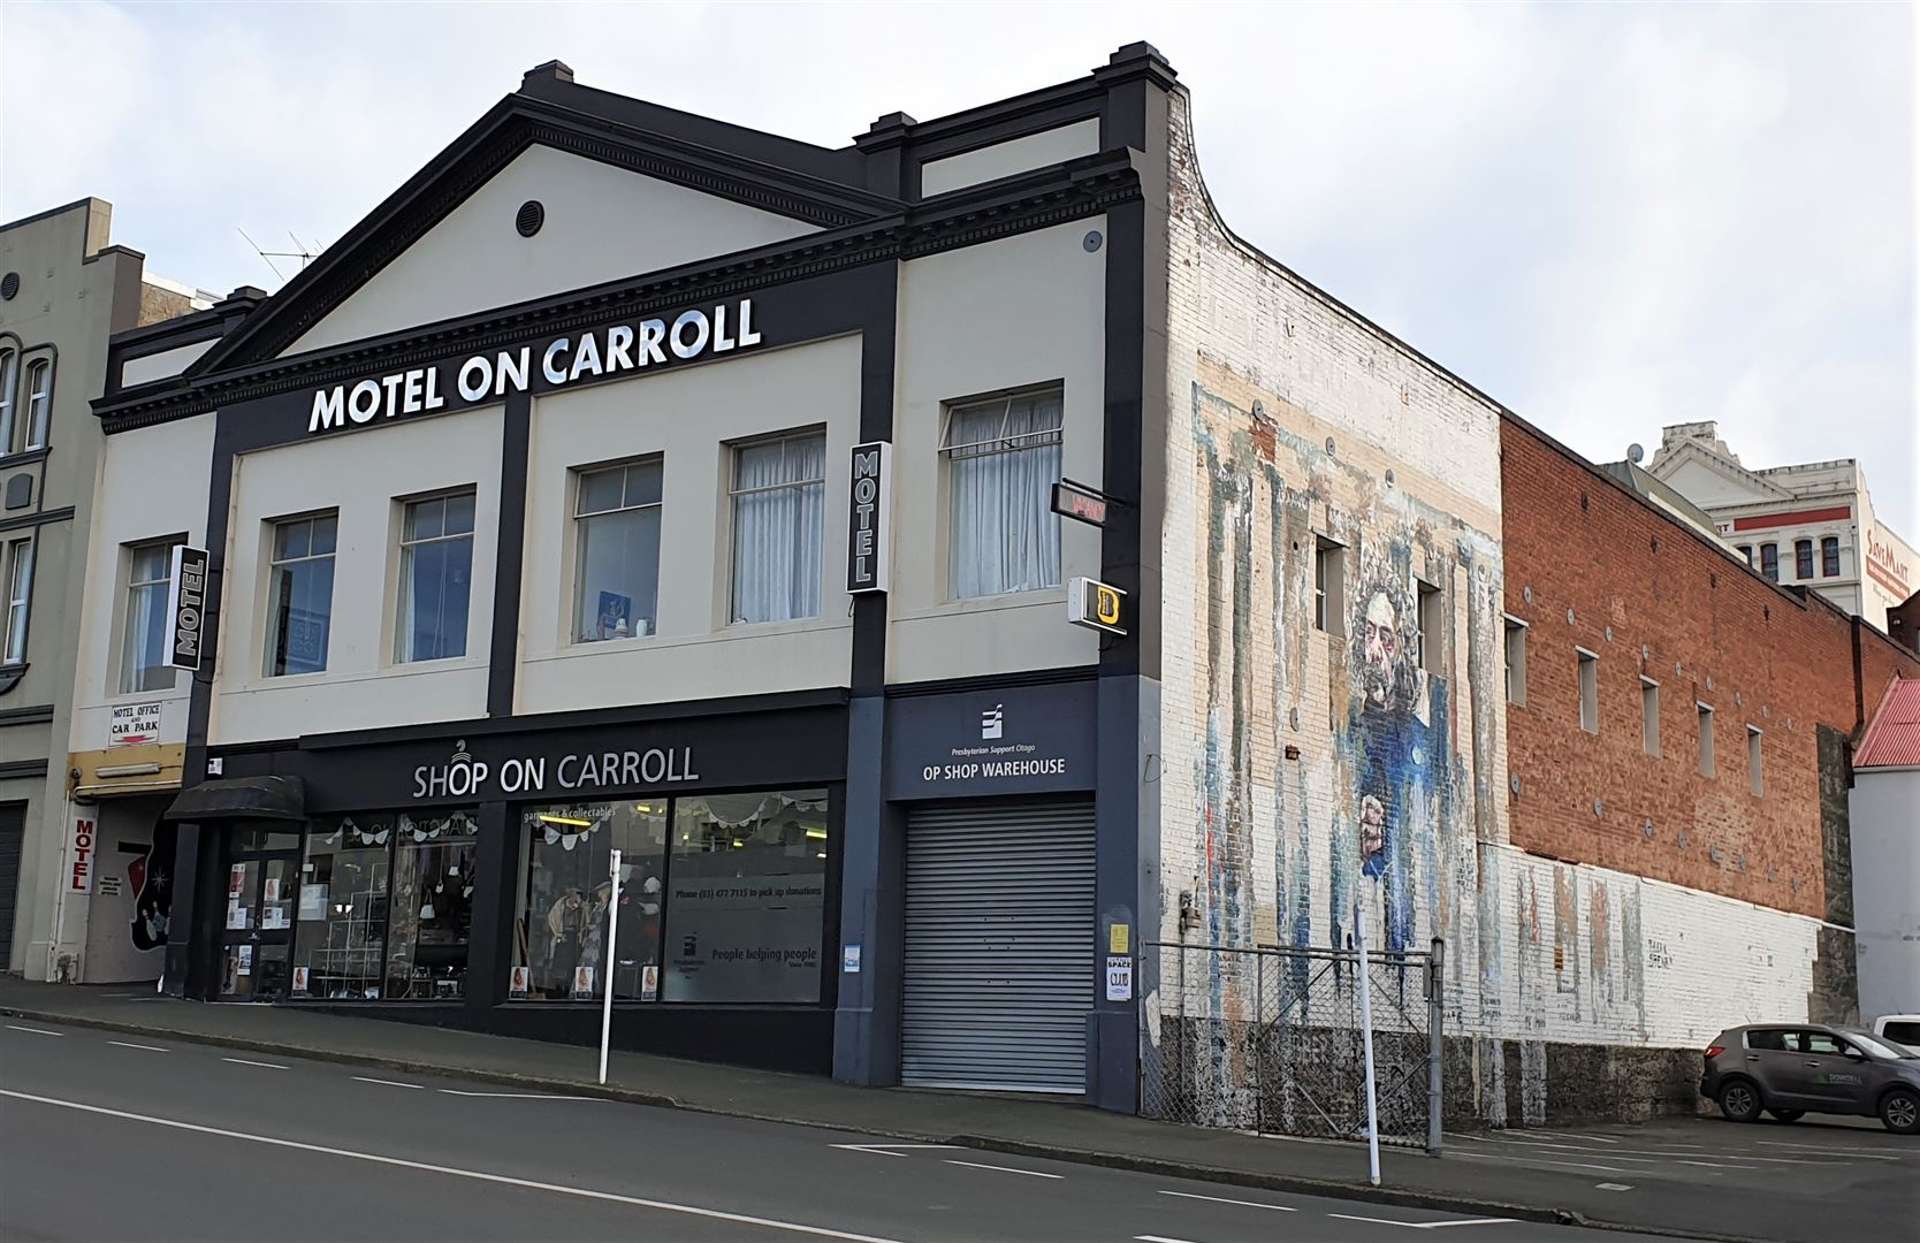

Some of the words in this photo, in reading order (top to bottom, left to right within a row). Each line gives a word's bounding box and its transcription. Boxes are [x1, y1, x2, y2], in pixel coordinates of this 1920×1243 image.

[308, 366, 444, 432] MOTEL
[457, 347, 530, 402] ON
[542, 299, 761, 385] CARROLL
[855, 451, 878, 582] MOTEL
[176, 559, 204, 656] MOTEL
[113, 707, 133, 718] MOTEL
[138, 704, 160, 715] OFFICE
[112, 724, 130, 734] CAR
[135, 721, 158, 732] PARK
[951, 747, 989, 757] Presbyterian
[990, 745, 1015, 755] Support
[1016, 744, 1036, 753] Otago
[413, 762, 488, 798] SHOP
[500, 758, 545, 792] ON
[557, 747, 699, 788] CARROLL
[923, 766, 941, 781] OP
[944, 764, 979, 780] SHOP
[982, 758, 1065, 777] WAREHOUSE
[569, 806, 616, 818] collectables
[72, 819, 93, 890] MOTEL
[712, 948, 744, 962] People
[745, 948, 782, 961] helping
[784, 947, 817, 962] people
